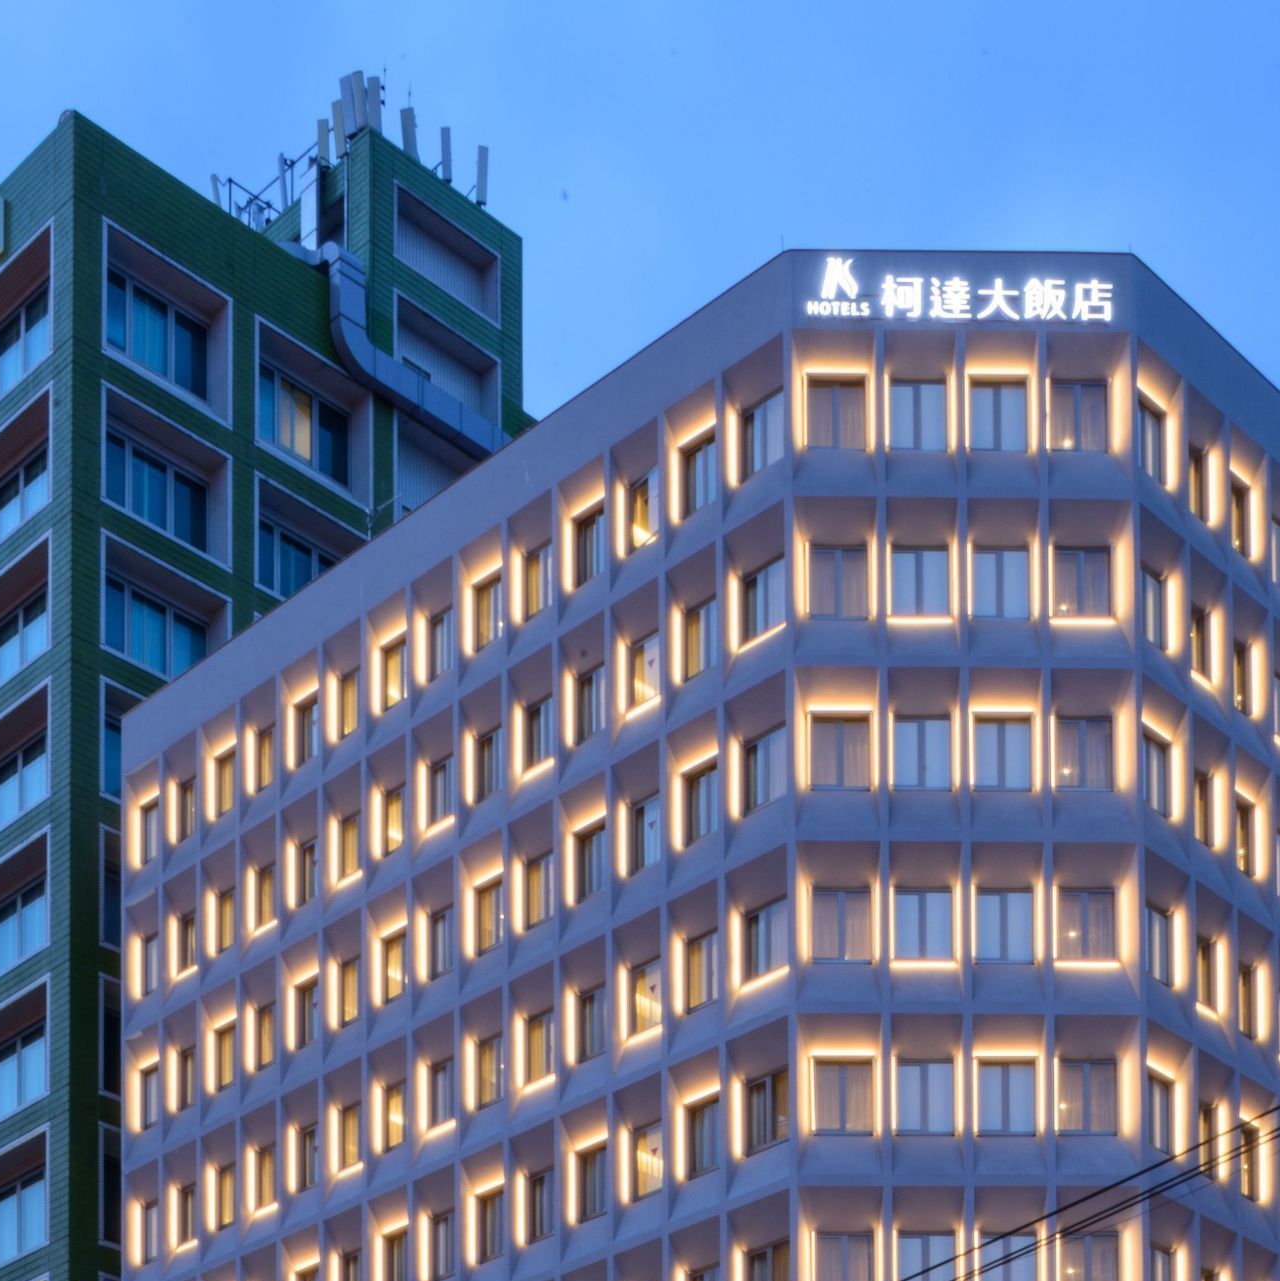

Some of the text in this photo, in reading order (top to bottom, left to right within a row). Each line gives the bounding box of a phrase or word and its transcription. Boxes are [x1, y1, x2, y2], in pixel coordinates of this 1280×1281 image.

[807, 300, 870, 317] HOTELS
[880, 275, 1114, 322] 柯達大飯店
